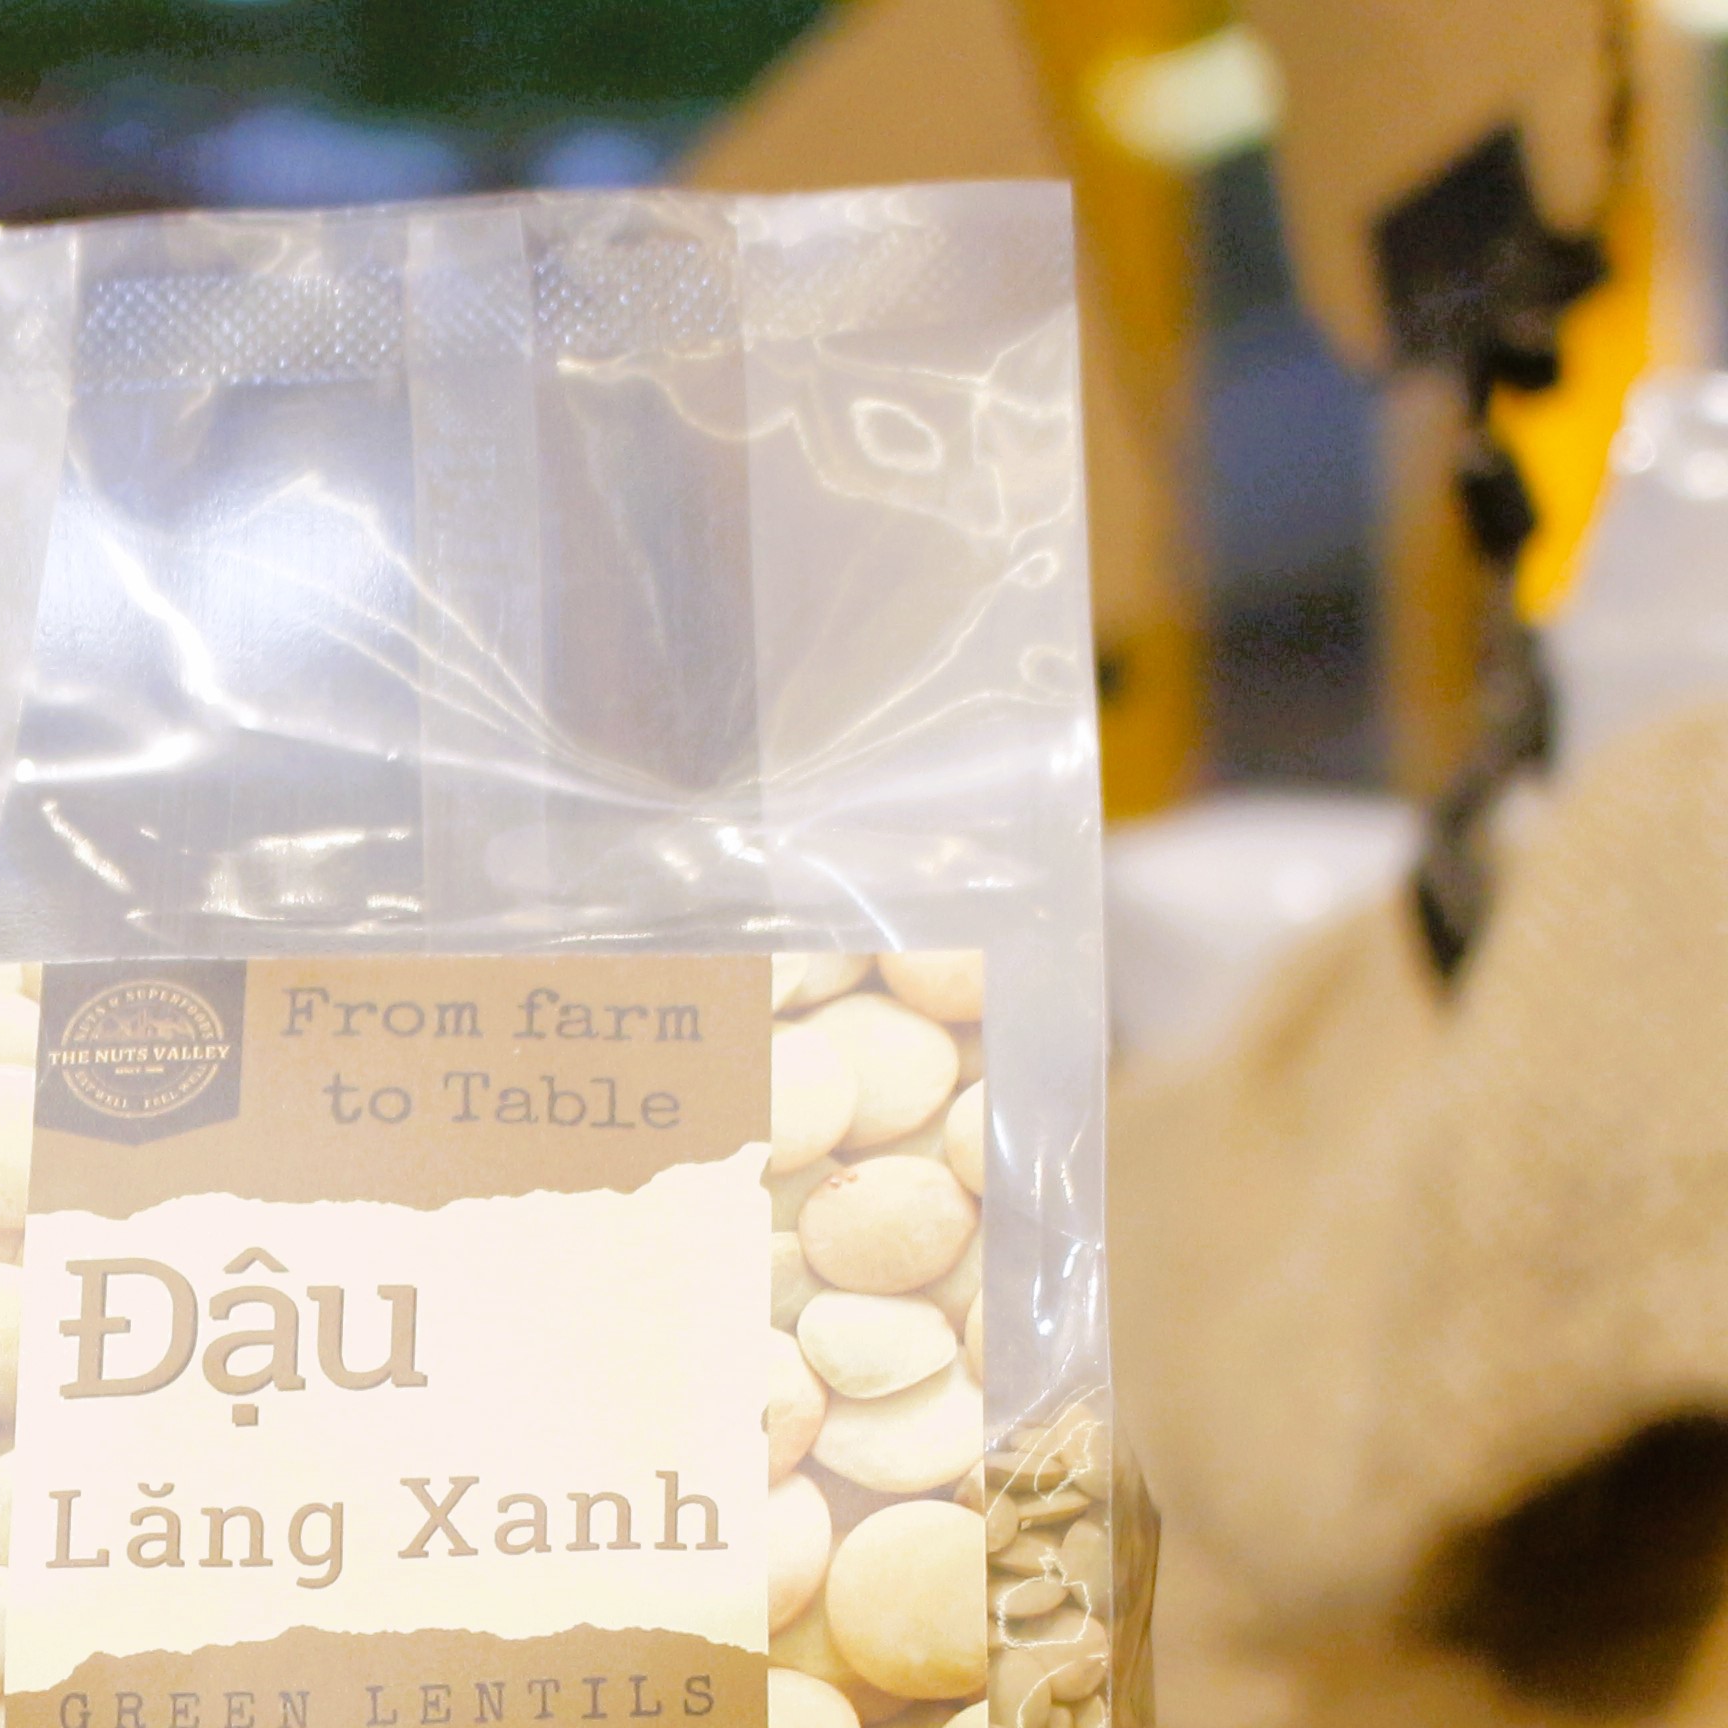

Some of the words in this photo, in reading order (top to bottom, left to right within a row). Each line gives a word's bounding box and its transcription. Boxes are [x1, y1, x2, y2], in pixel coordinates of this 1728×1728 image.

[282, 987, 480, 1041] From
[513, 988, 703, 1041] farm
[48, 1050, 89, 1065] THE
[94, 1046, 148, 1063] NUTS
[153, 1044, 232, 1061] VALLEY
[324, 1077, 413, 1127] to
[442, 1071, 683, 1130] Table
[59, 1246, 428, 1426] Đậu
[46, 1482, 344, 1589] Lăng
[397, 1470, 728, 1559] Xanh
[366, 1675, 716, 1728] LENTILS
